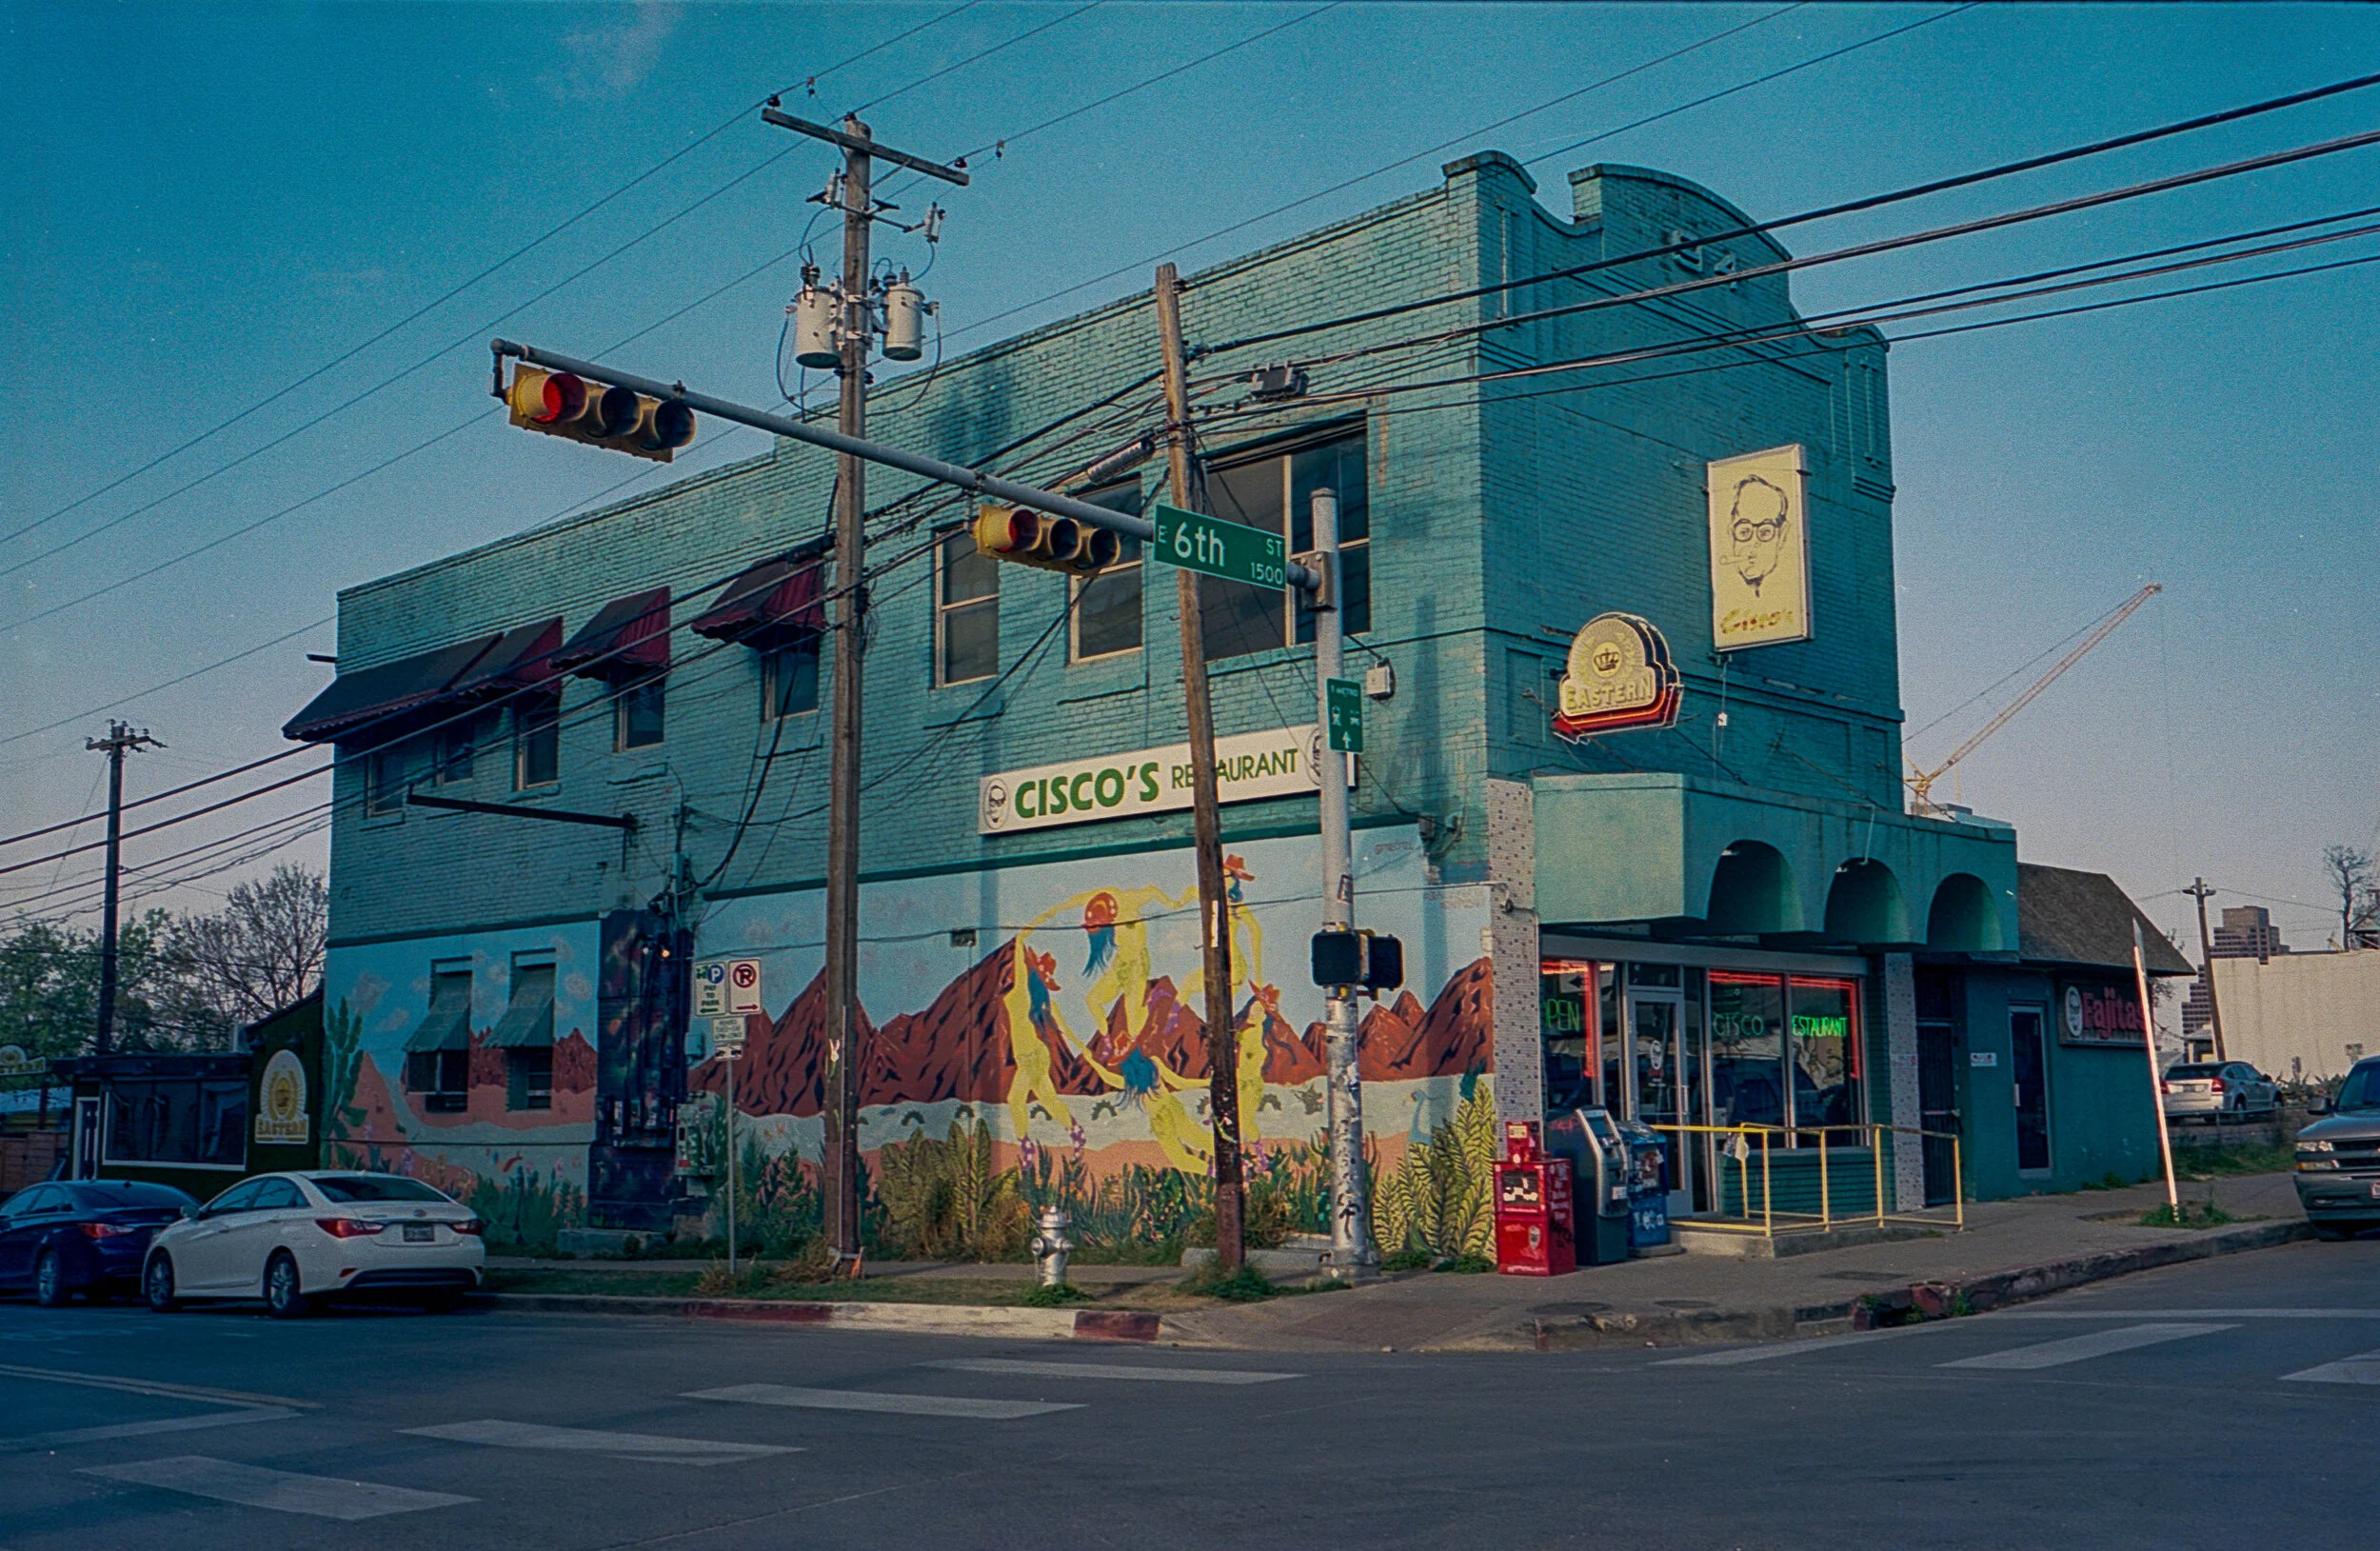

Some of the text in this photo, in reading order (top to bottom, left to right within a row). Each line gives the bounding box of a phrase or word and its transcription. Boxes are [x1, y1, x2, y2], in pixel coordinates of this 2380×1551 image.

[1158, 521, 1283, 567] E 6th ST
[1250, 561, 1284, 586] 1500
[1565, 674, 1654, 710] EASTERN
[1014, 747, 1299, 820] CISCO'S REAURANT
[1545, 998, 1580, 1032] PEN
[1791, 1015, 1848, 1037] ESTAURANT
